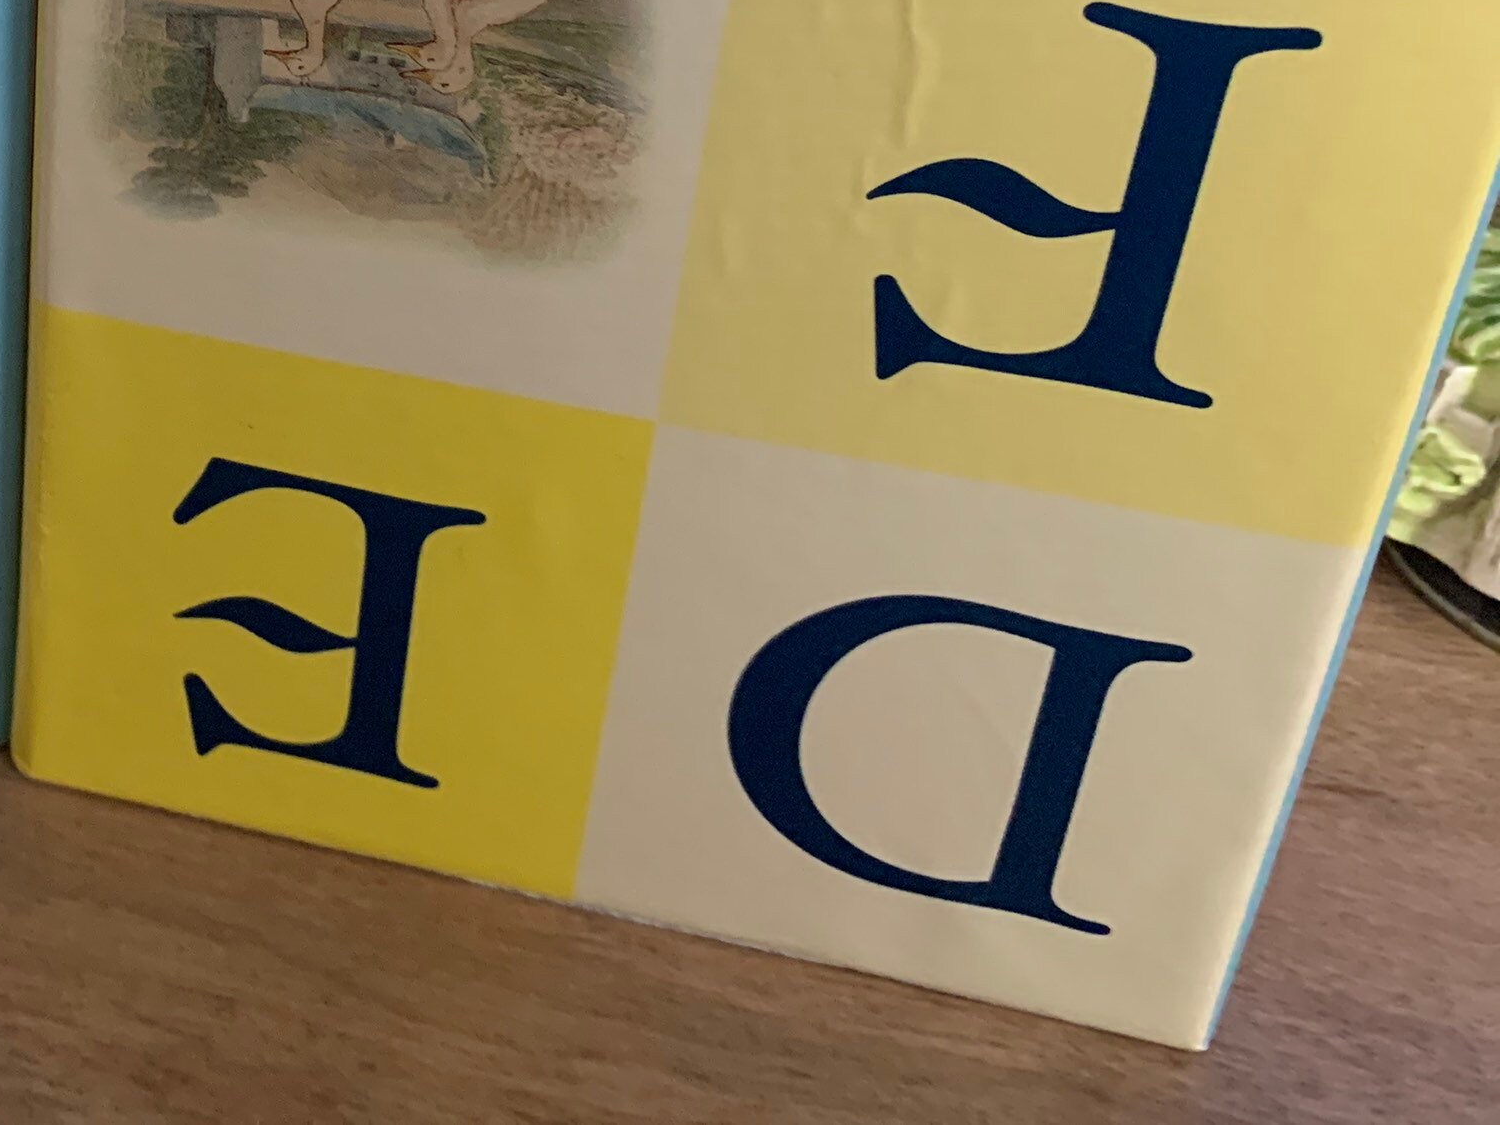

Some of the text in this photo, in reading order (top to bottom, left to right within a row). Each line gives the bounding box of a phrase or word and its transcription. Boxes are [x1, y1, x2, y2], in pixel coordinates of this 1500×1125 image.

[866, 1, 1324, 409] F
[172, 457, 487, 790] E
[726, 594, 1192, 938] D
